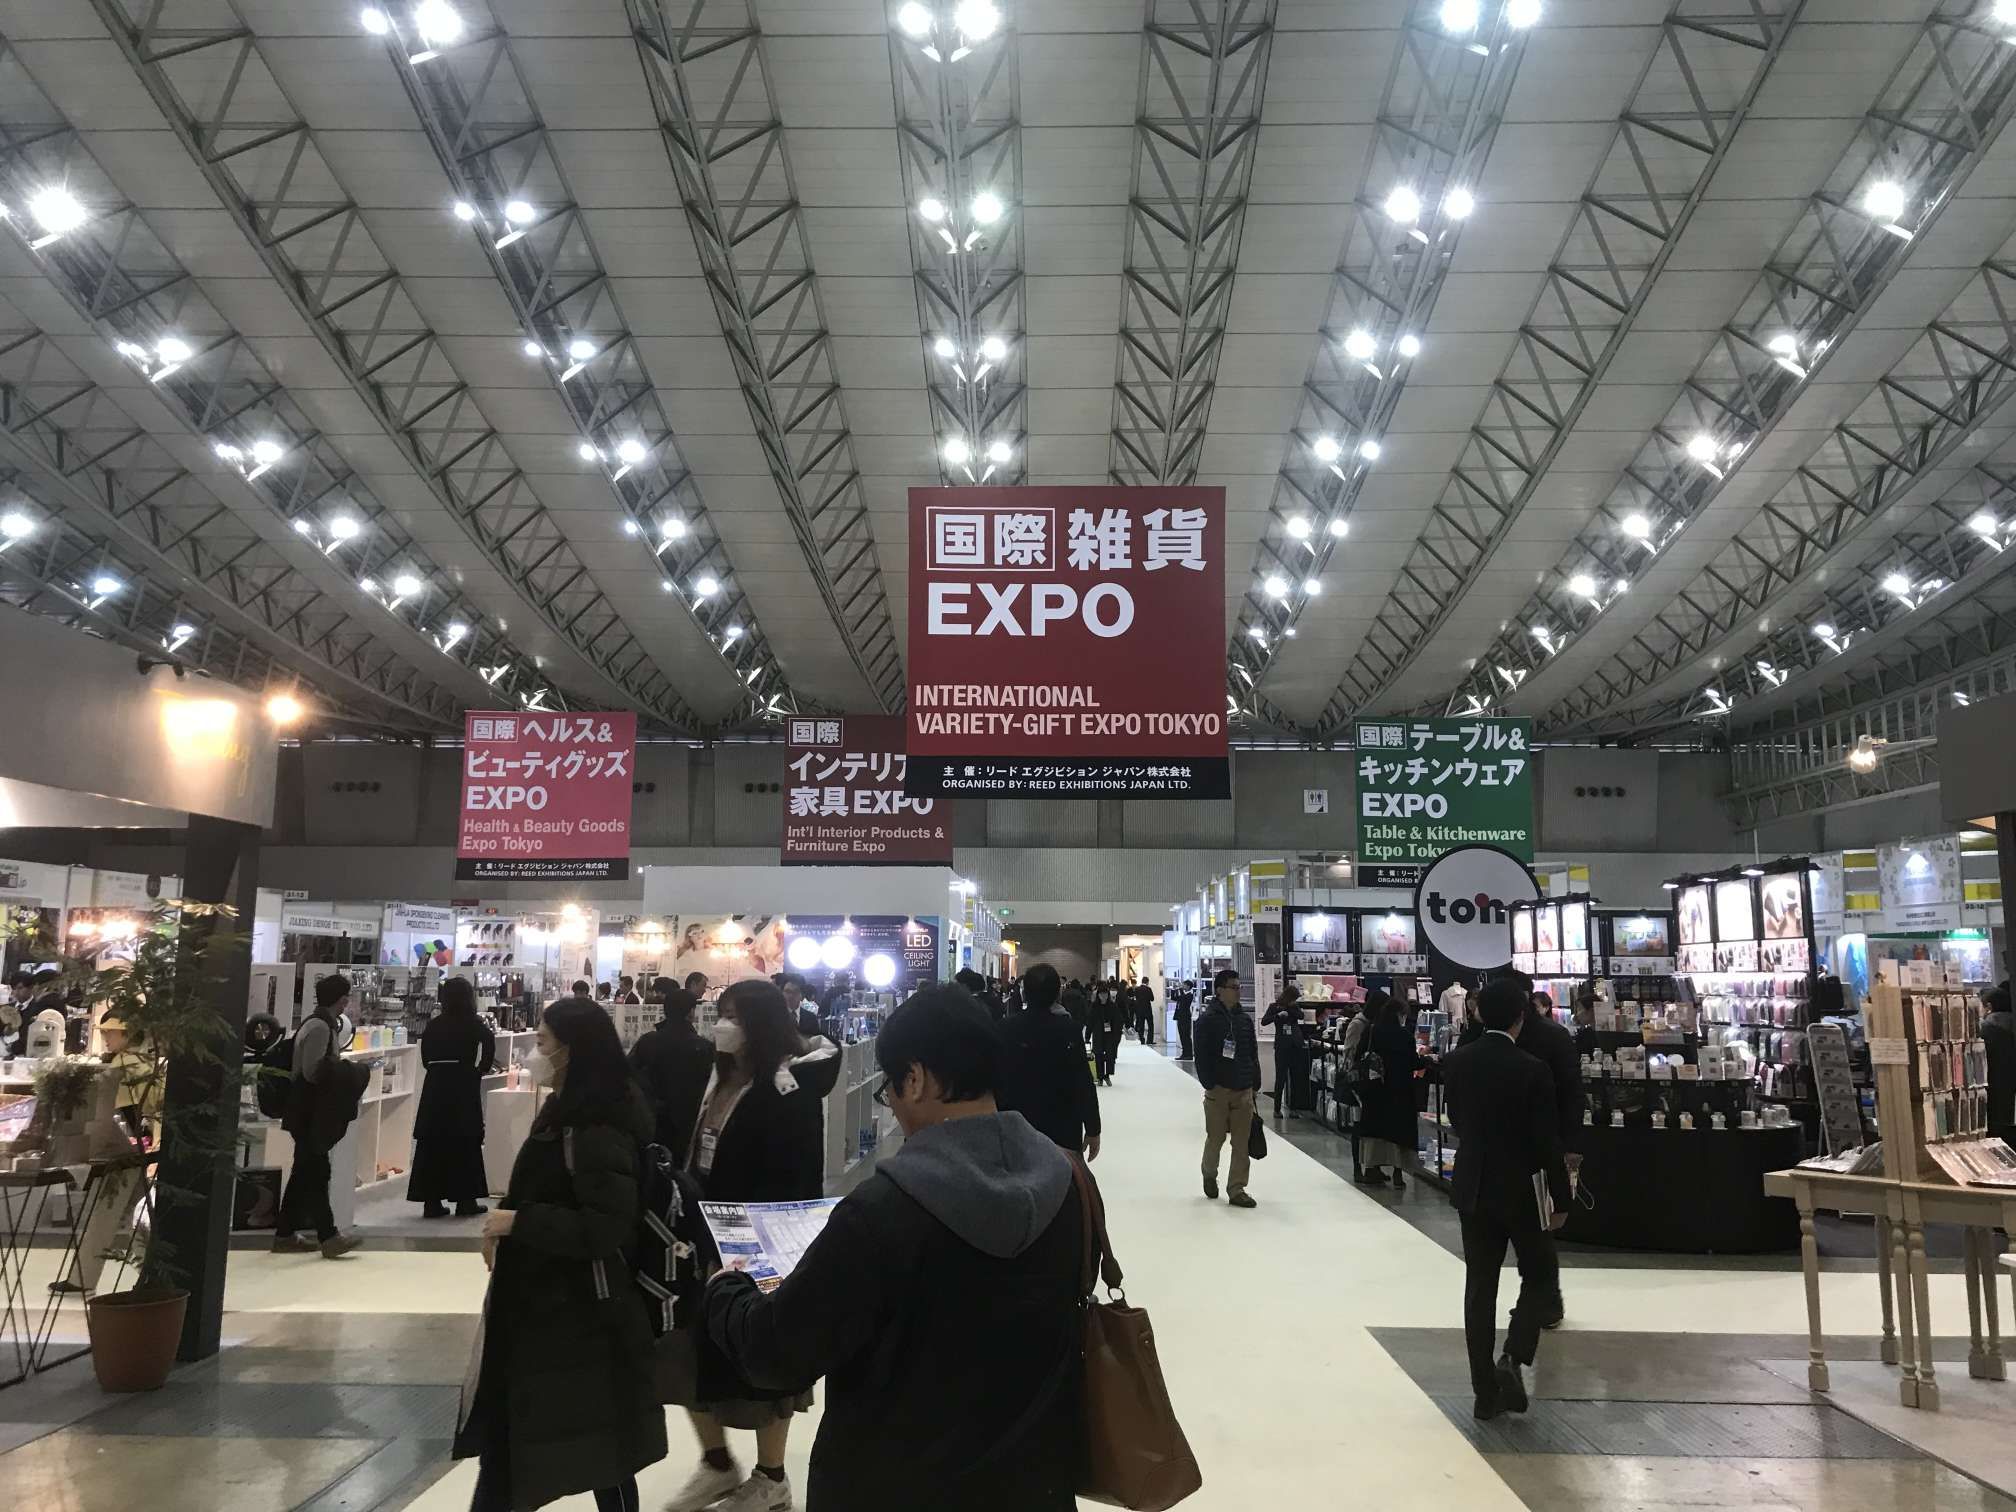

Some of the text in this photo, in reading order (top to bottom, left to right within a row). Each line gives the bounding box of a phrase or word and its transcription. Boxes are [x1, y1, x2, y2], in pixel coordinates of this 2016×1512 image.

[927, 582, 1135, 638] EXPO
[915, 684, 1100, 707] INTERNATIONAL
[792, 721, 840, 744] 国際
[916, 713, 1220, 735] VARIETY-GIFT EXPO TOKYO
[467, 749, 630, 780] ビューティグッズ
[1358, 755, 1526, 787] キッチンウェア
[942, 779, 1192, 790] ORGANISED BY: REED EXHIBITIONS JAPAN LTD.
[466, 786, 548, 810] EXPO
[853, 789, 934, 815] EXPO
[1362, 792, 1448, 818] EXPO
[463, 818, 625, 836] Health & Beauty Goods
[817, 825, 867, 838] Interior
[871, 826, 931, 839] Products
[935, 827, 944, 839] &
[1363, 824, 1526, 841] Table & Kitchenware
[462, 836, 544, 853] Expo Tokyo
[786, 839, 886, 855] Furniture Expo
[1365, 842, 1452, 860] Expo Toky
[906, 934, 932, 947] LED
[903, 952, 934, 960] CEILING
